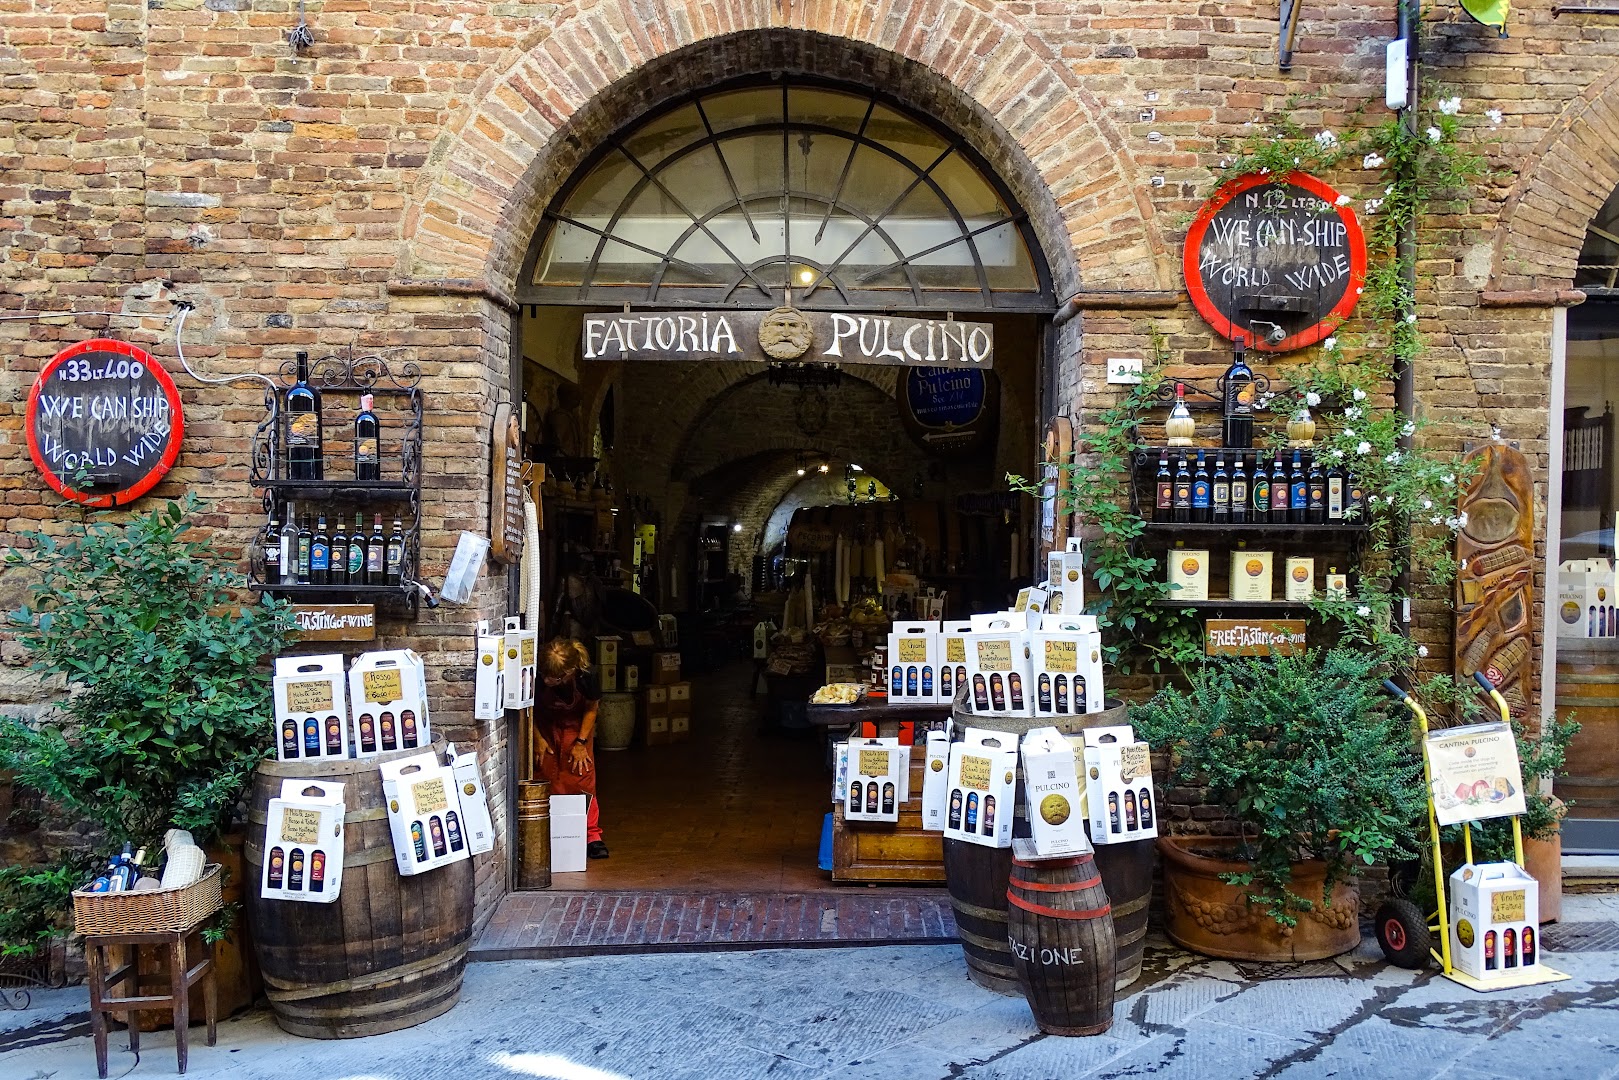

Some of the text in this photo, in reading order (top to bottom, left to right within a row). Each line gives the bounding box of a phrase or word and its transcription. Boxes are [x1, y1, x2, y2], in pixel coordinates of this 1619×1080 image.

[1199, 251, 1350, 291] WORLD WIDE
[584, 312, 993, 363] FATTORIA PULCINO
[918, 377, 971, 396] Pulcino
[40, 395, 169, 420] WE CAN SHIP
[44, 420, 171, 470] WORLD WIDE
[978, 641, 985, 651] 3
[1046, 641, 1053, 652] 3
[1439, 736, 1500, 749] CANTINA PULCINO
[1035, 782, 1070, 792] PULCINO
[1455, 905, 1477, 920] PULCINO
